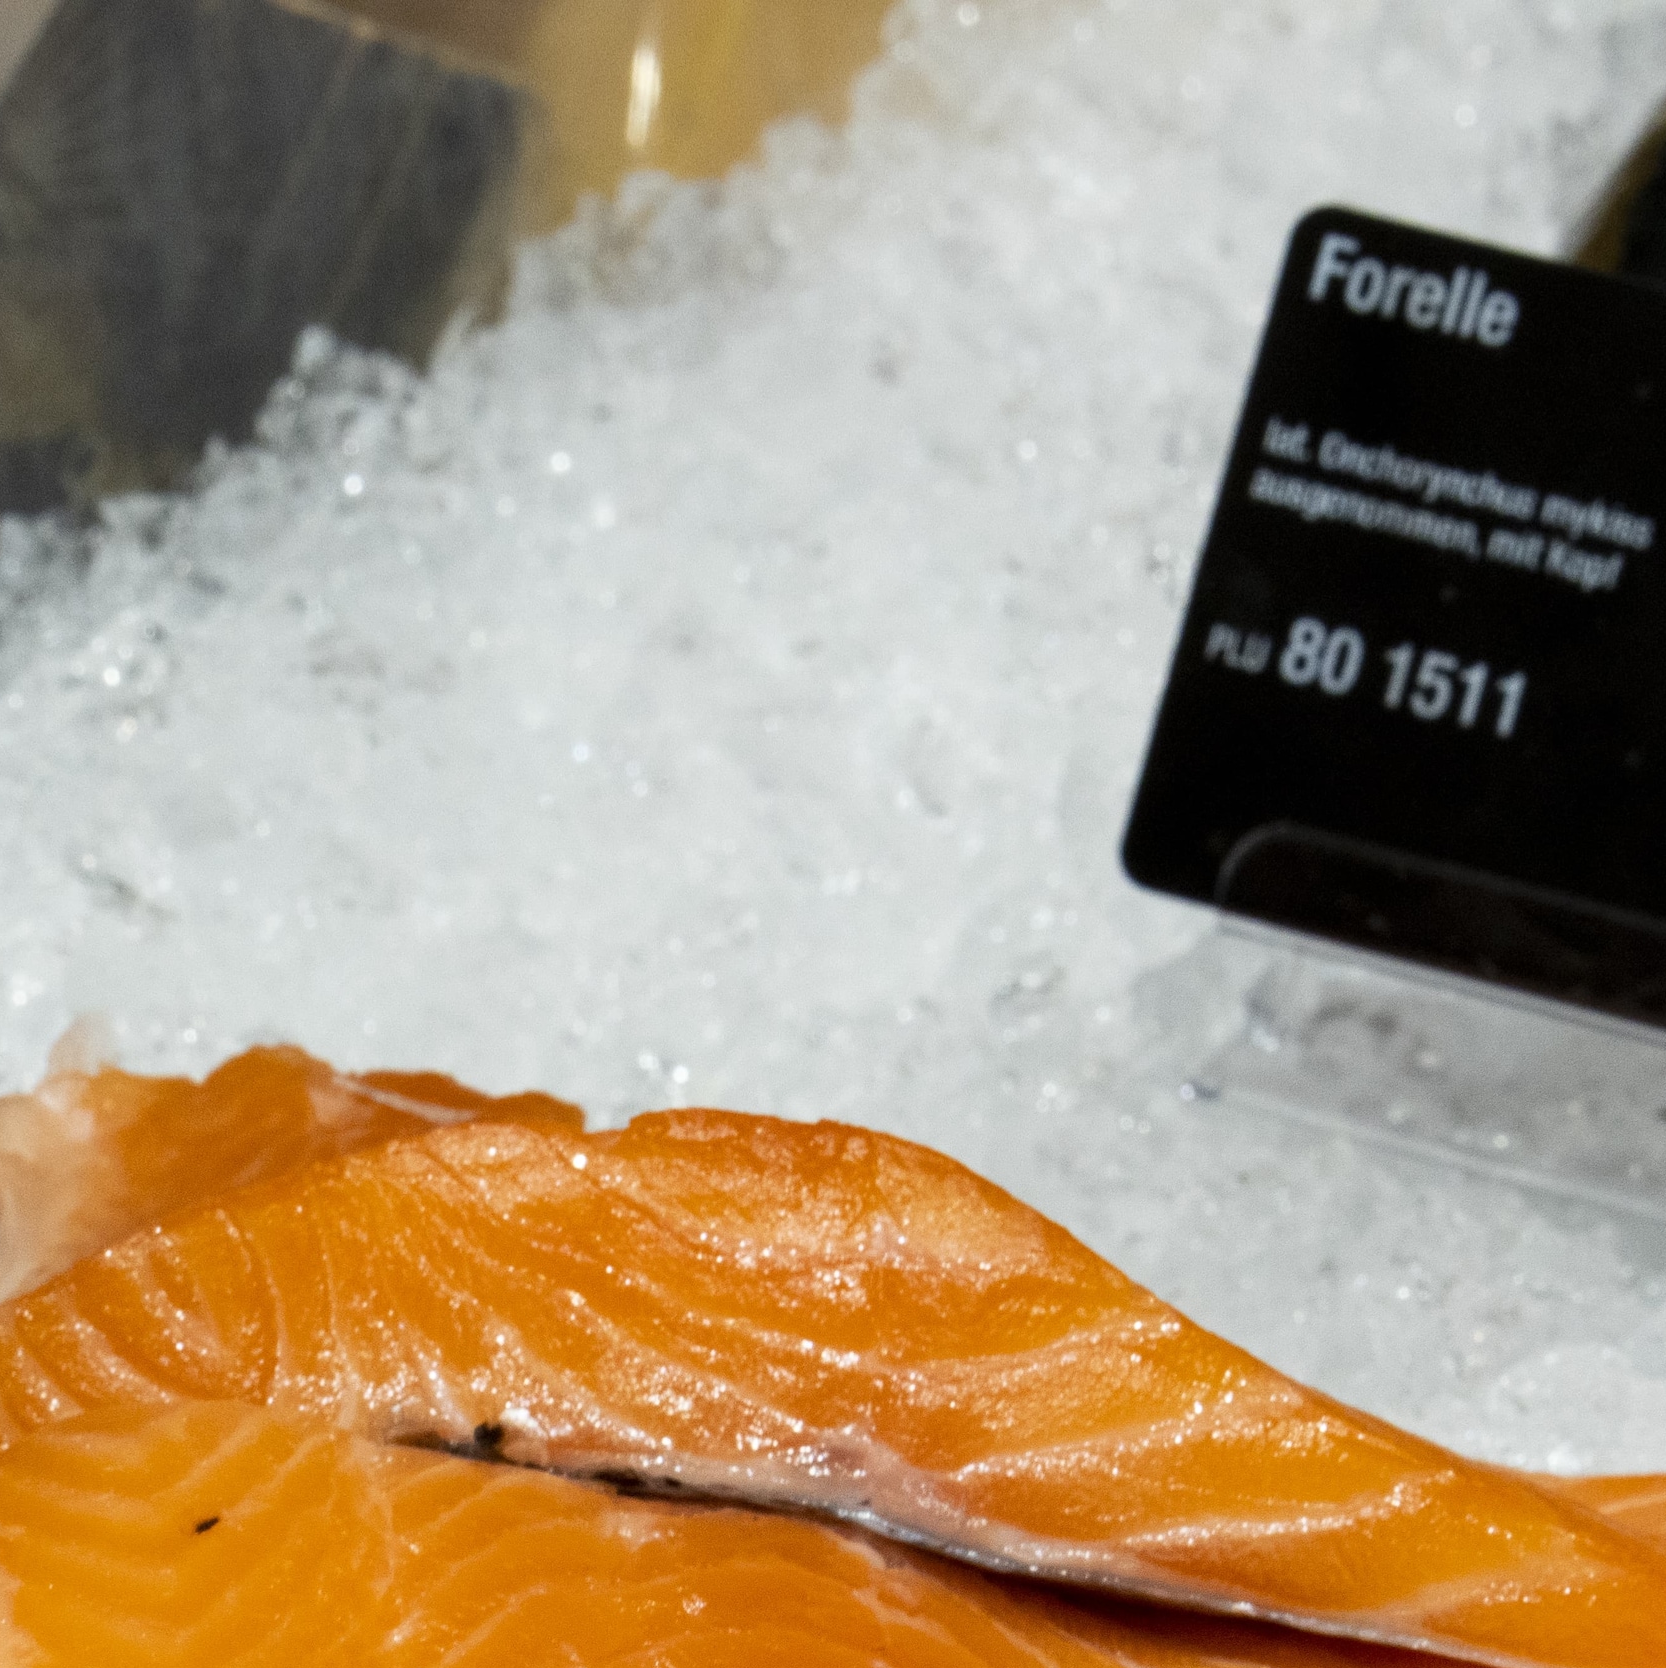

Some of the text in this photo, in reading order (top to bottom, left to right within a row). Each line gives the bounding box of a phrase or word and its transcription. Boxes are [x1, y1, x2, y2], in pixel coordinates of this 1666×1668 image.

[1308, 233, 1520, 348] Forelle
[1486, 528, 1546, 574] mit
[1545, 541, 1625, 593] Kopf
[1540, 490, 1656, 552] mykiss
[1205, 615, 1529, 740] PLU 80 1511
